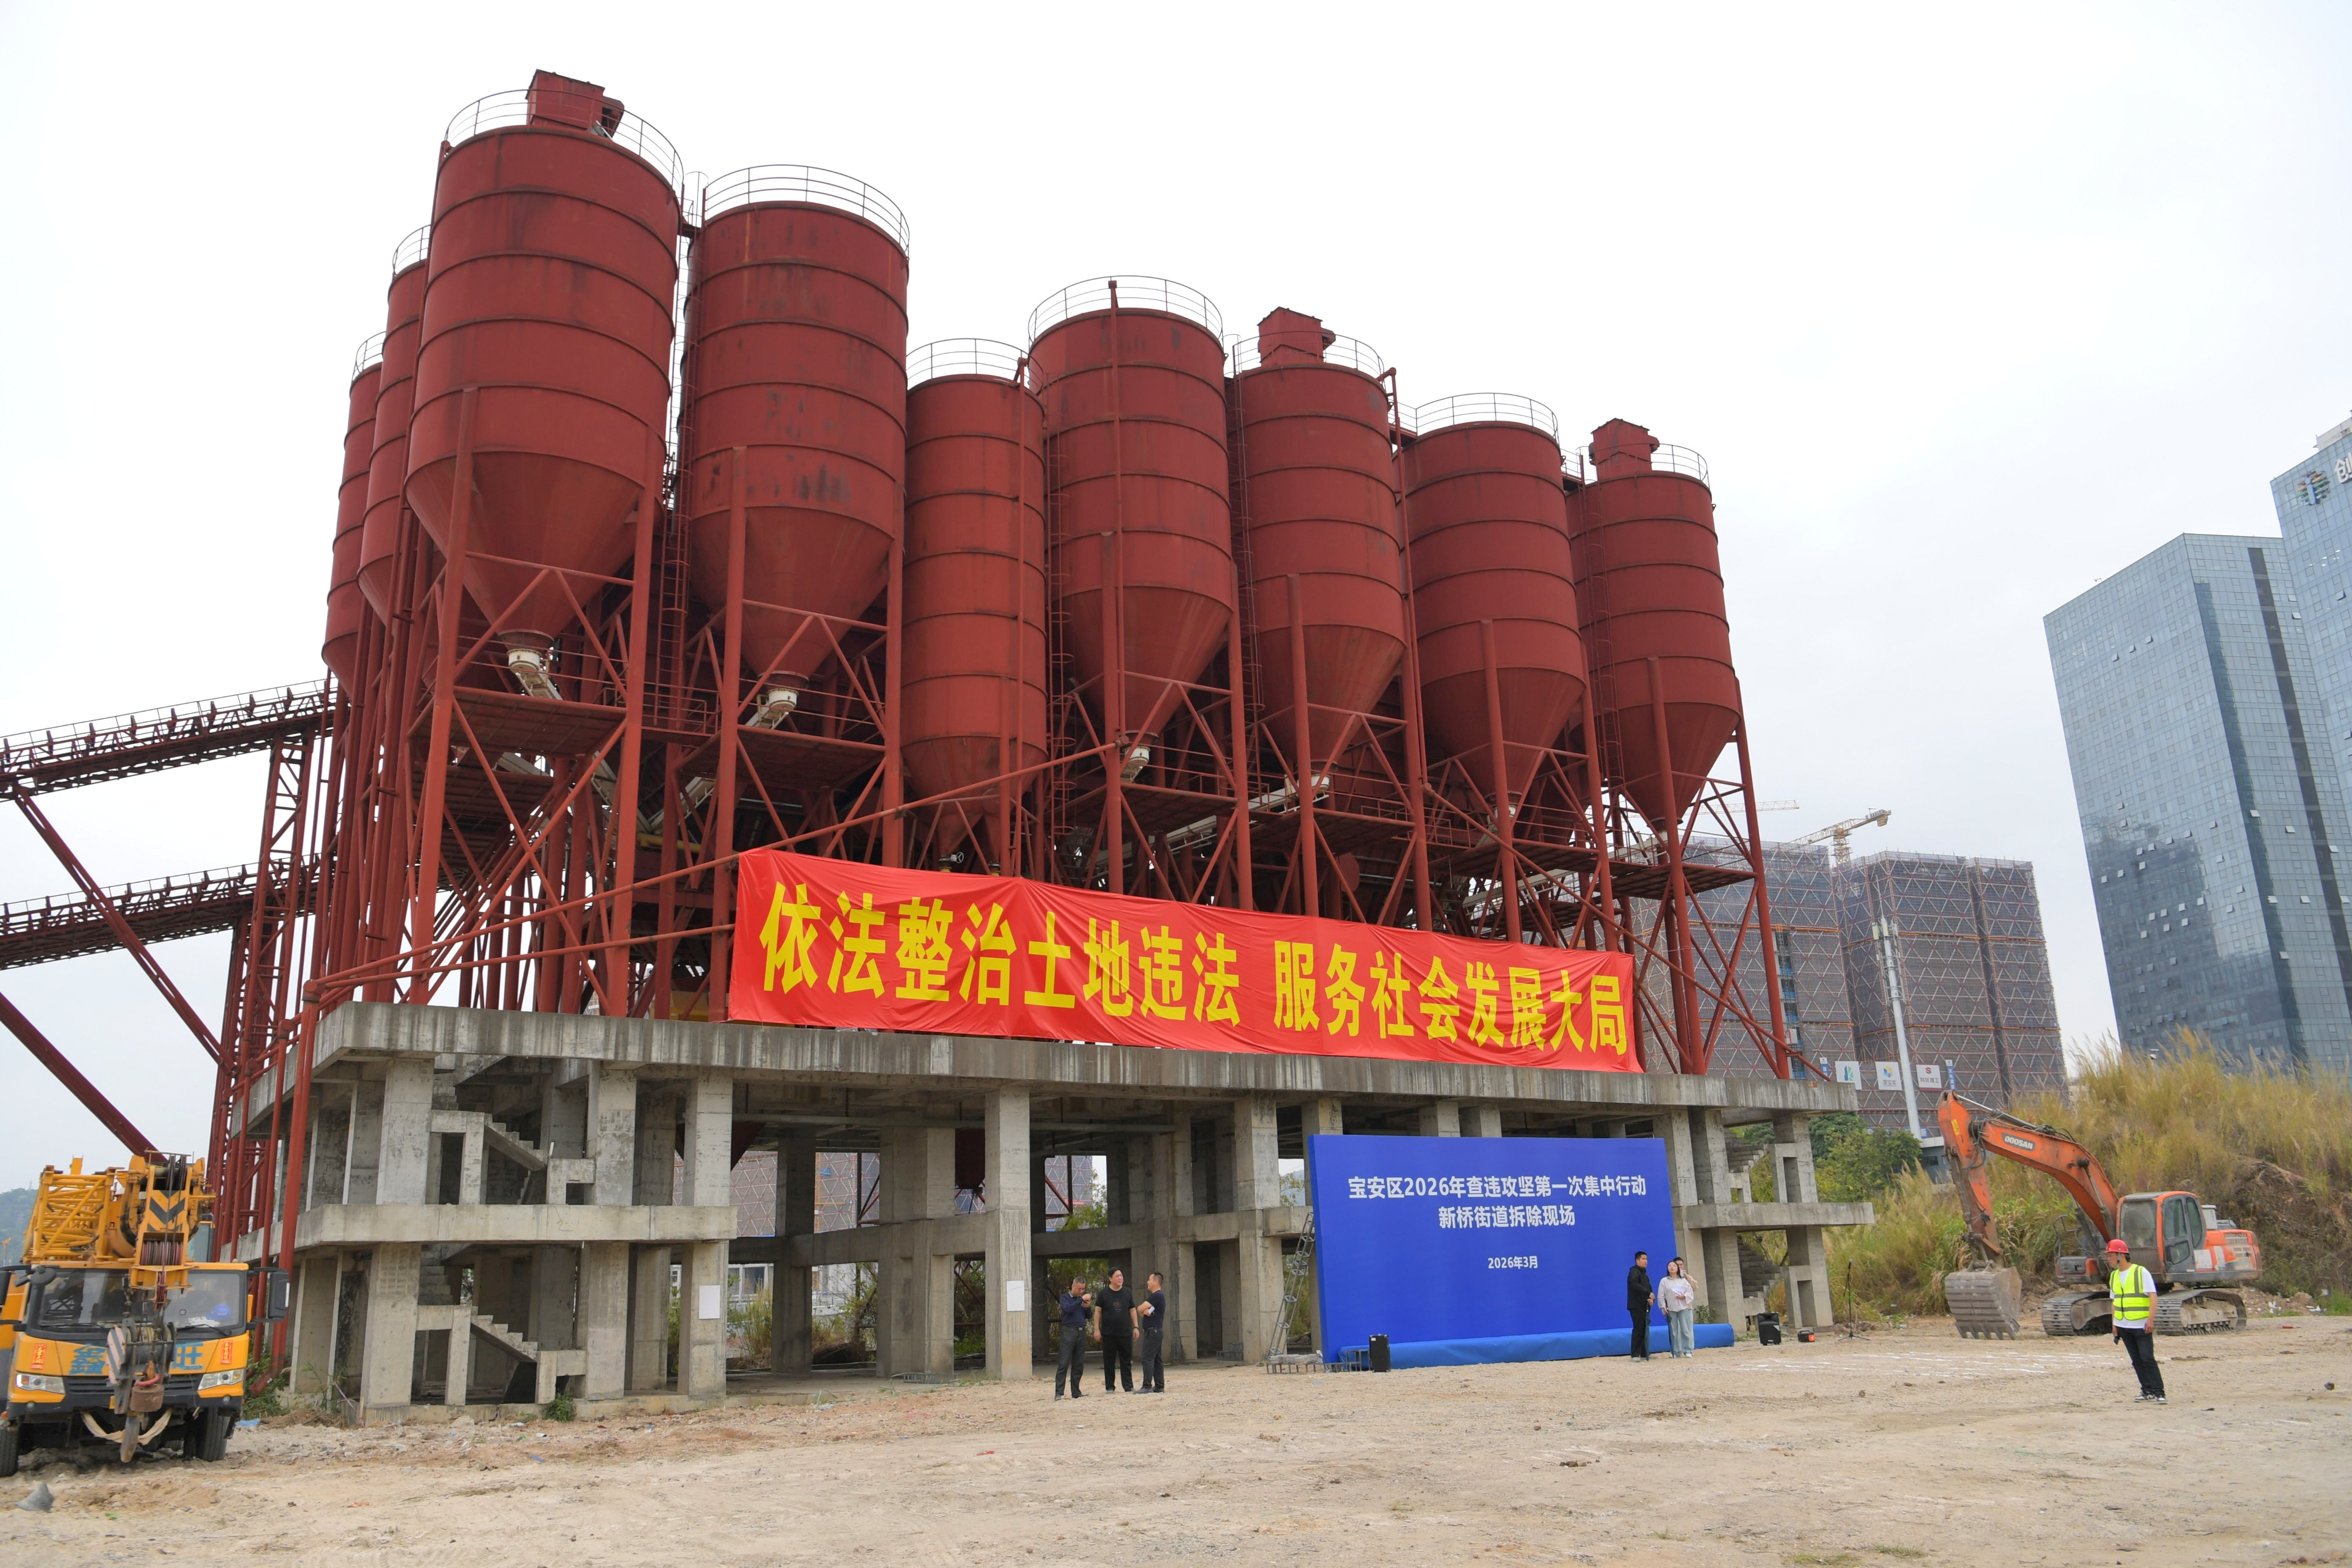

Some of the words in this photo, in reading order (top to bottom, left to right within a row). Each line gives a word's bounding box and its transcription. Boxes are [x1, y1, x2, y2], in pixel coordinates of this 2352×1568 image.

[759, 881, 1241, 1027] 依法整治土地违法
[1273, 940, 1627, 1056] 服务社会发展大局
[2005, 1135, 2033, 1150] DOOSAN
[1348, 1175, 1646, 1199] 宝安区2026年查违攻坚第一次集中行动
[1438, 1205, 1575, 1229] 新桥街道拆除现场
[1488, 1256, 1538, 1269] 2026年3月
